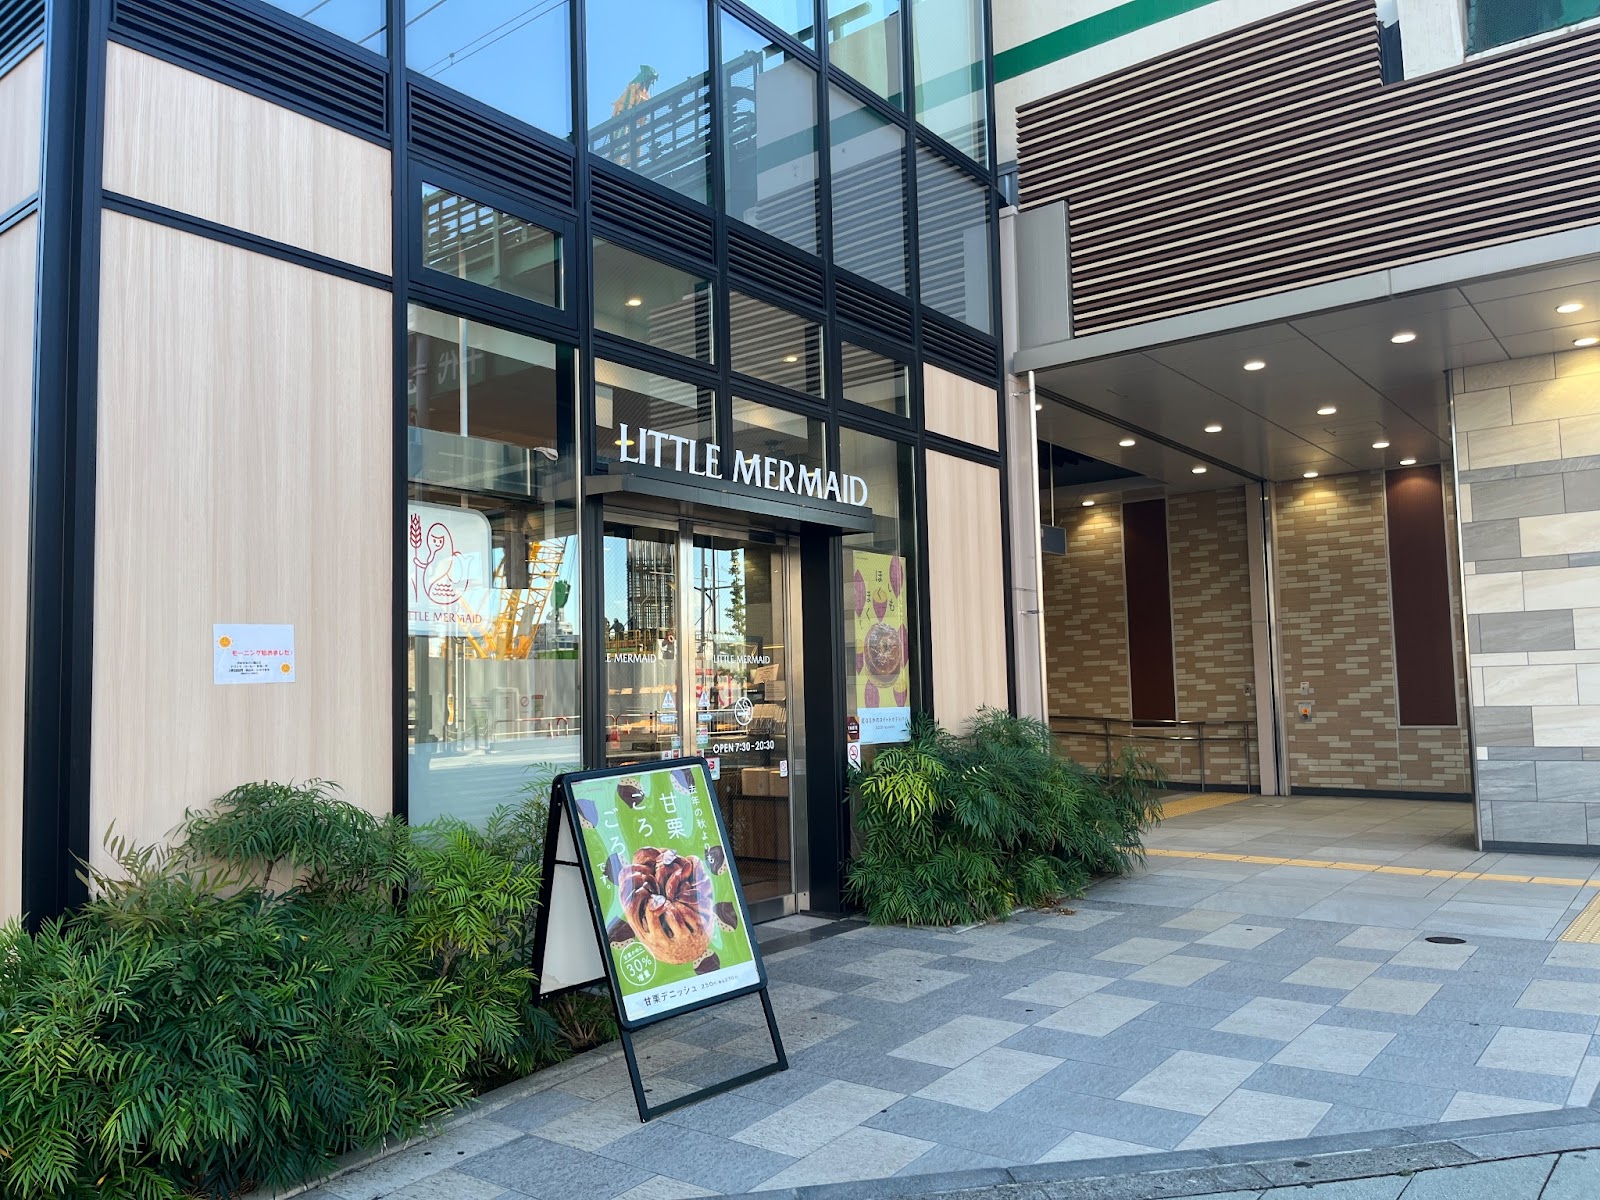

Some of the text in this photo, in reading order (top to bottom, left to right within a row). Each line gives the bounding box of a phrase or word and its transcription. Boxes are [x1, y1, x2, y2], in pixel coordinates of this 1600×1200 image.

[619, 422, 868, 508] LITTLE MERMAID
[614, 653, 657, 663] MERMAID
[713, 653, 771, 665] LITTLE MERMAID
[712, 743, 734, 754] OPEN
[631, 789, 653, 838] ごろ
[659, 791, 687, 839] 甘栗
[688, 784, 716, 864] 去年の秋よりも
[603, 807, 626, 856] ごろ
[626, 955, 652, 977] 30%
[643, 985, 698, 1007] 甘栗デニッシュ
